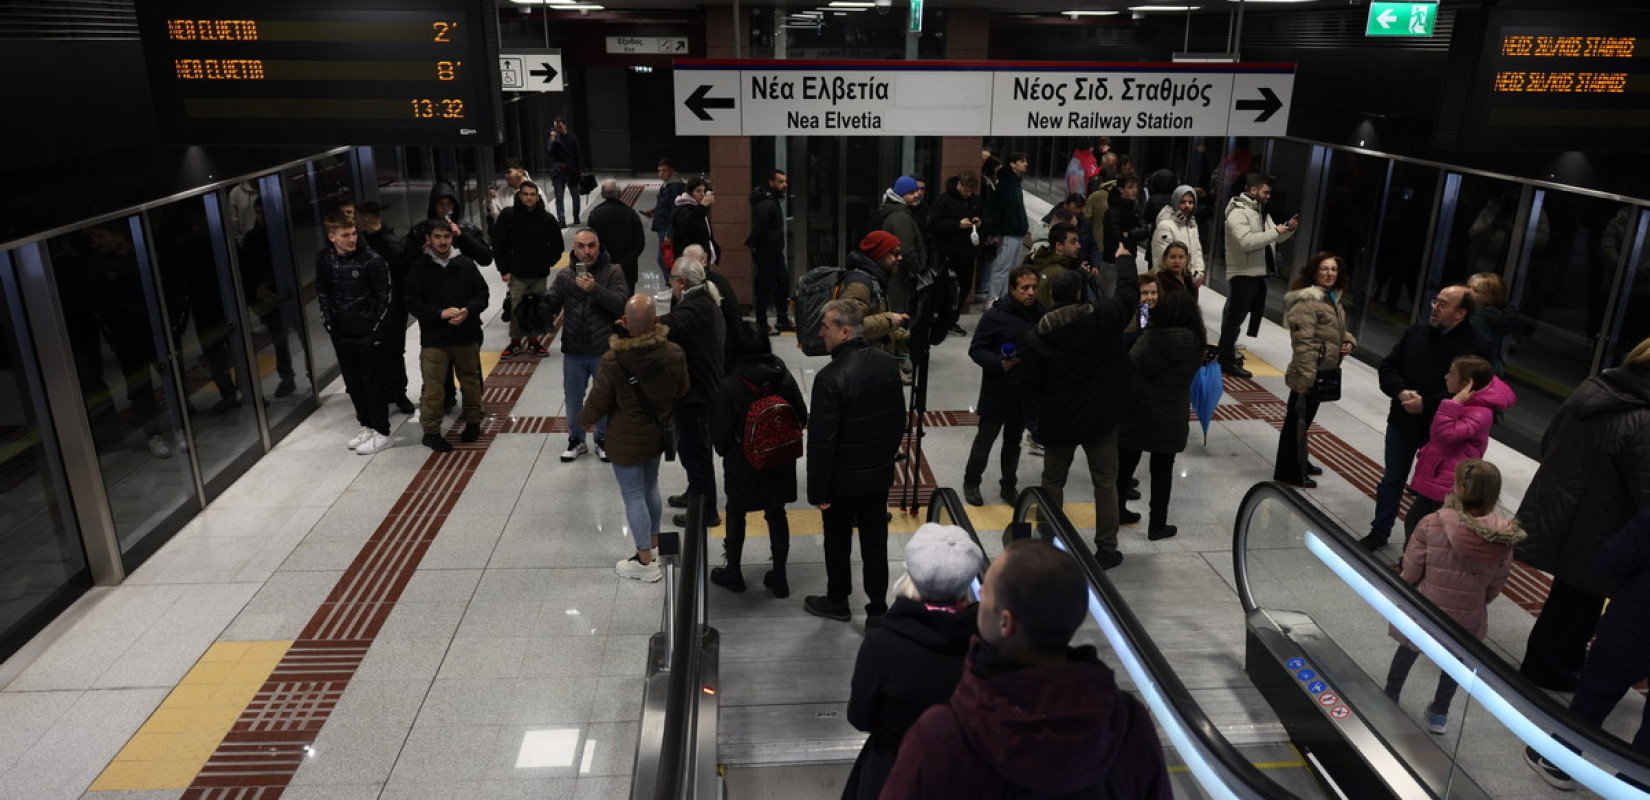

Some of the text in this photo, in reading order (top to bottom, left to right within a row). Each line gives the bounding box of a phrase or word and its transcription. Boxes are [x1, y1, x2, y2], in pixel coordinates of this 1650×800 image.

[167, 19, 258, 41] NEA ELVETIA
[175, 59, 265, 80] NEA ELVETIA
[751, 75, 889, 105] Νέα Ελβετία
[1013, 77, 1213, 107] Νέος Σιδ. Σταθμός
[410, 98, 464, 118] 13:32
[787, 110, 881, 129] Nea Elvetia
[1027, 111, 1193, 134] New Railway Station
